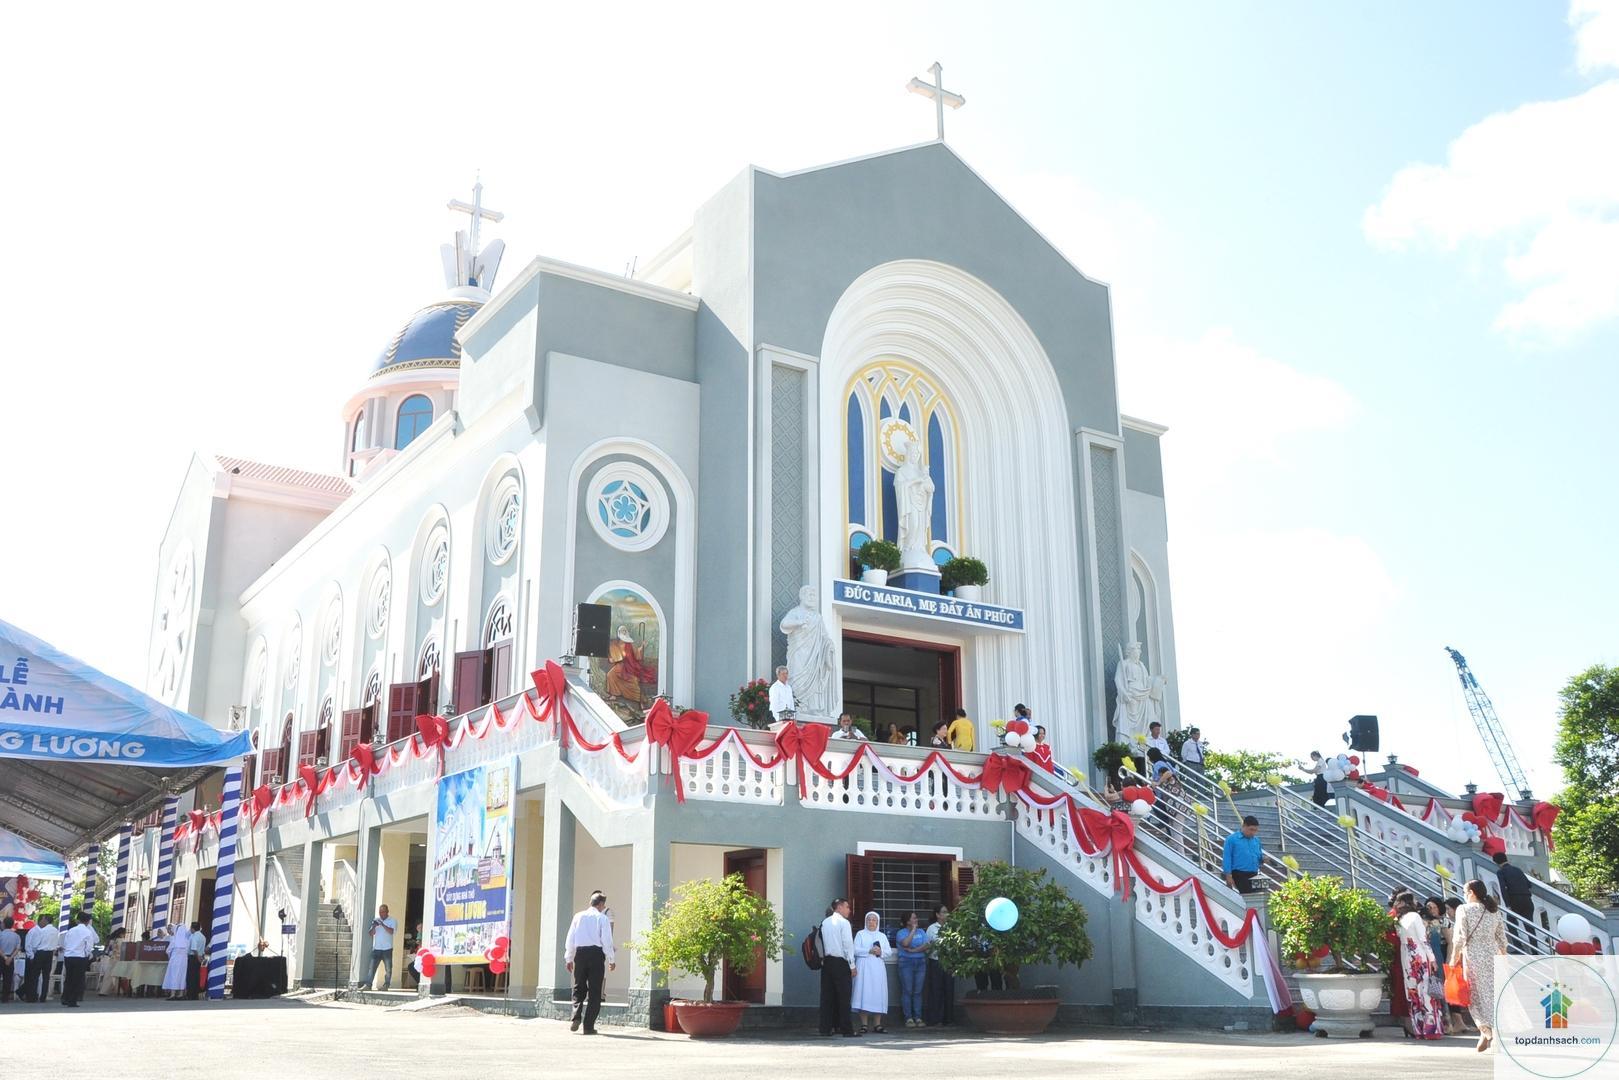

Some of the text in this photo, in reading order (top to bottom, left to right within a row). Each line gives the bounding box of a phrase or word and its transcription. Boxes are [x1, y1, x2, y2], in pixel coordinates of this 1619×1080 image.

[844, 585, 871, 602] ĐỨC
[873, 591, 917, 612] MARIA,
[918, 599, 937, 615] MẸ
[965, 604, 982, 619] ÂN
[984, 609, 1015, 625] PHÚC
[0, 657, 29, 685] LỄ
[0, 687, 64, 715] ÀNH
[31, 734, 146, 758] LƯƠNG
